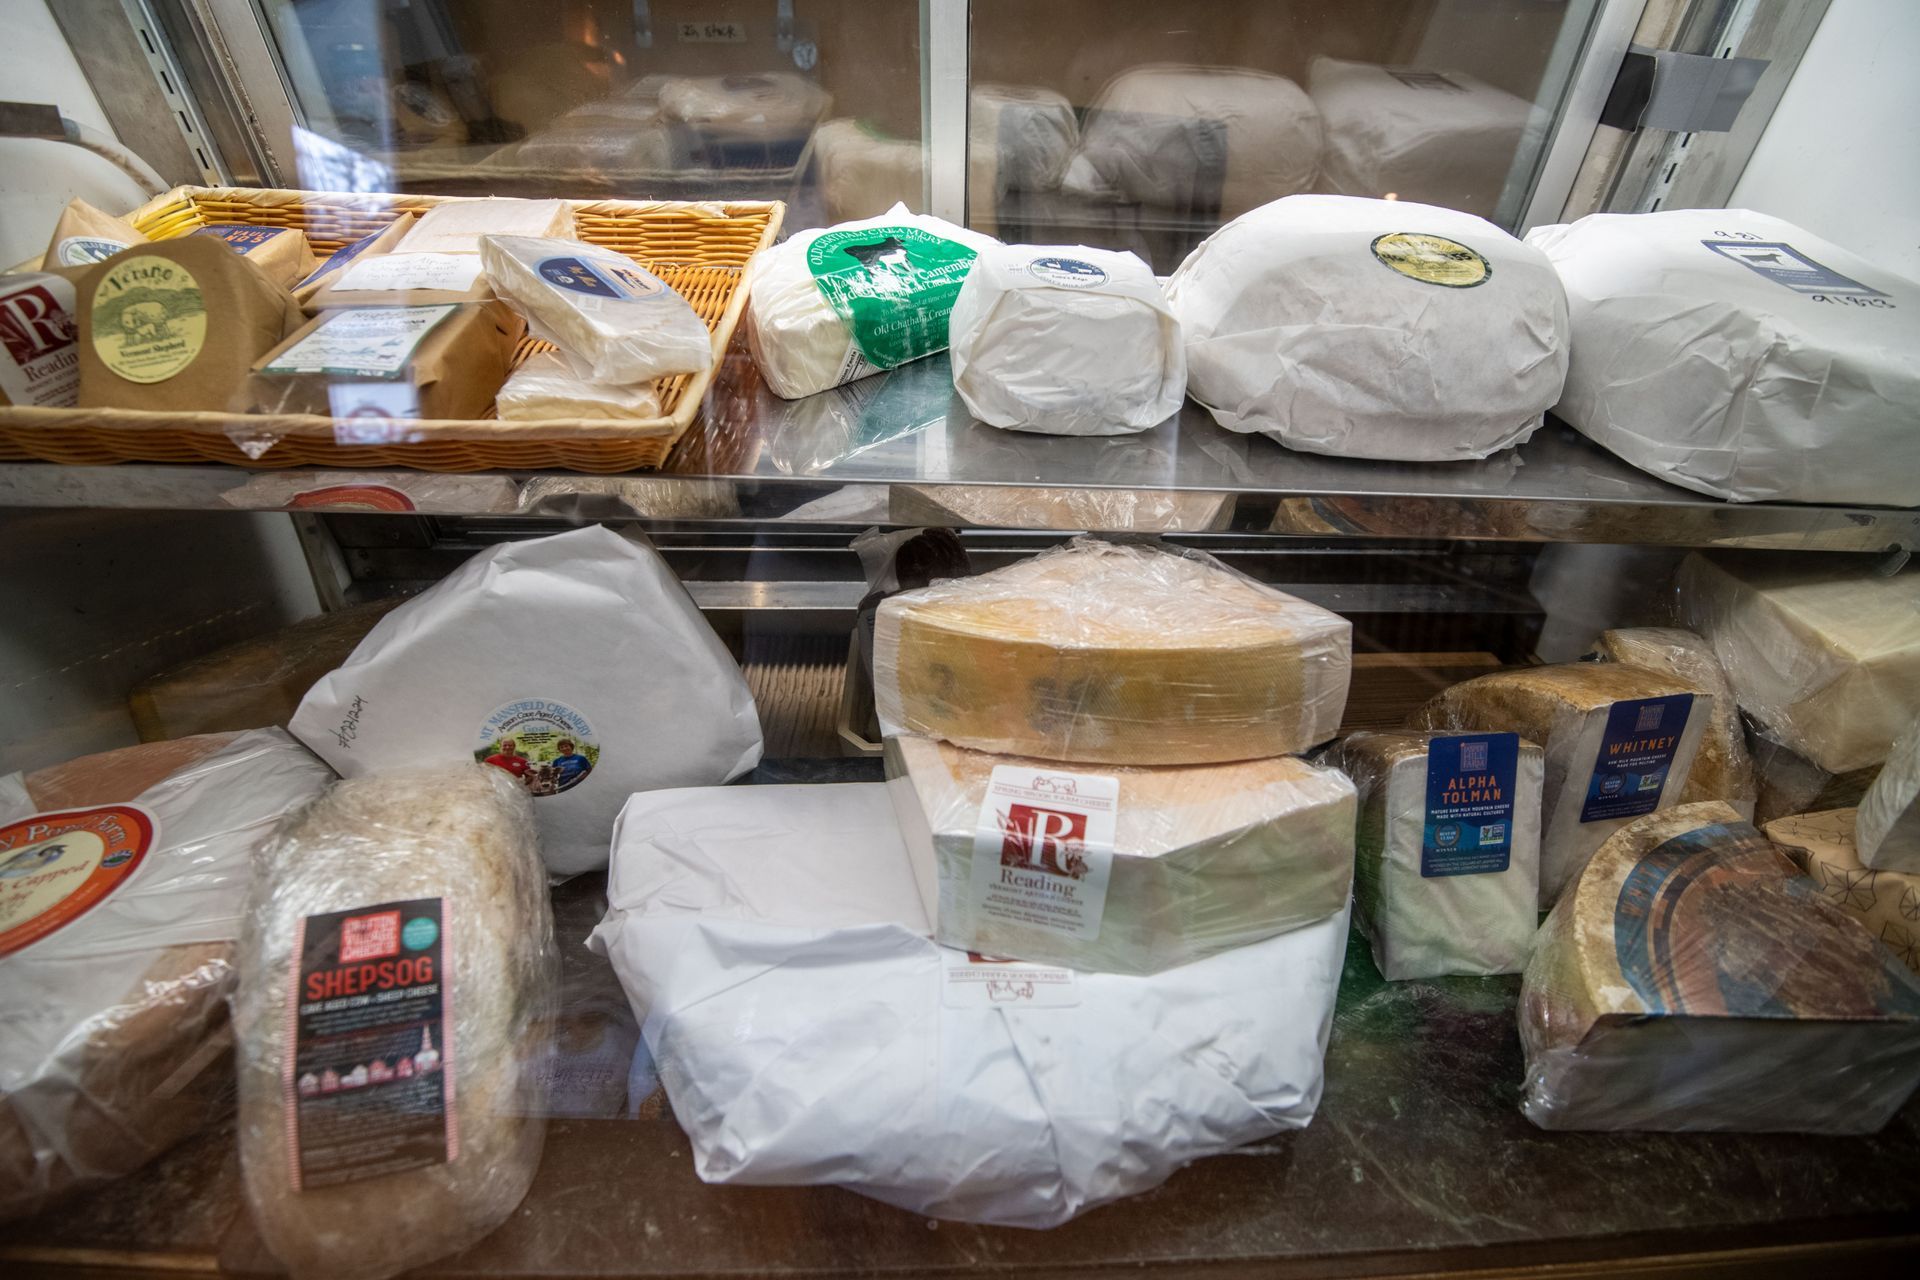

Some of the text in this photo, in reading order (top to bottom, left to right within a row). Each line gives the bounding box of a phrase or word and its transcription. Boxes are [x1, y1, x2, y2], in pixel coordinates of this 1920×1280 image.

[818, 231, 866, 249] CHATHAM
[867, 228, 945, 245] CREAMERY
[873, 322, 889, 336] Old
[890, 313, 929, 332] Chatham
[928, 306, 953, 321] Cream
[23, 352, 80, 382] Readin
[488, 701, 545, 724] MANSFIELD
[546, 702, 593, 737] CREAMERY
[535, 710, 554, 720] Aged
[523, 725, 550, 733] Goat
[1609, 736, 1675, 755] WHITNEY
[1448, 776, 1497, 790] ALPHA
[1442, 789, 1502, 804] TOLMAN
[1001, 868, 1078, 898] Reading
[306, 956, 433, 999] SHEPSOG
